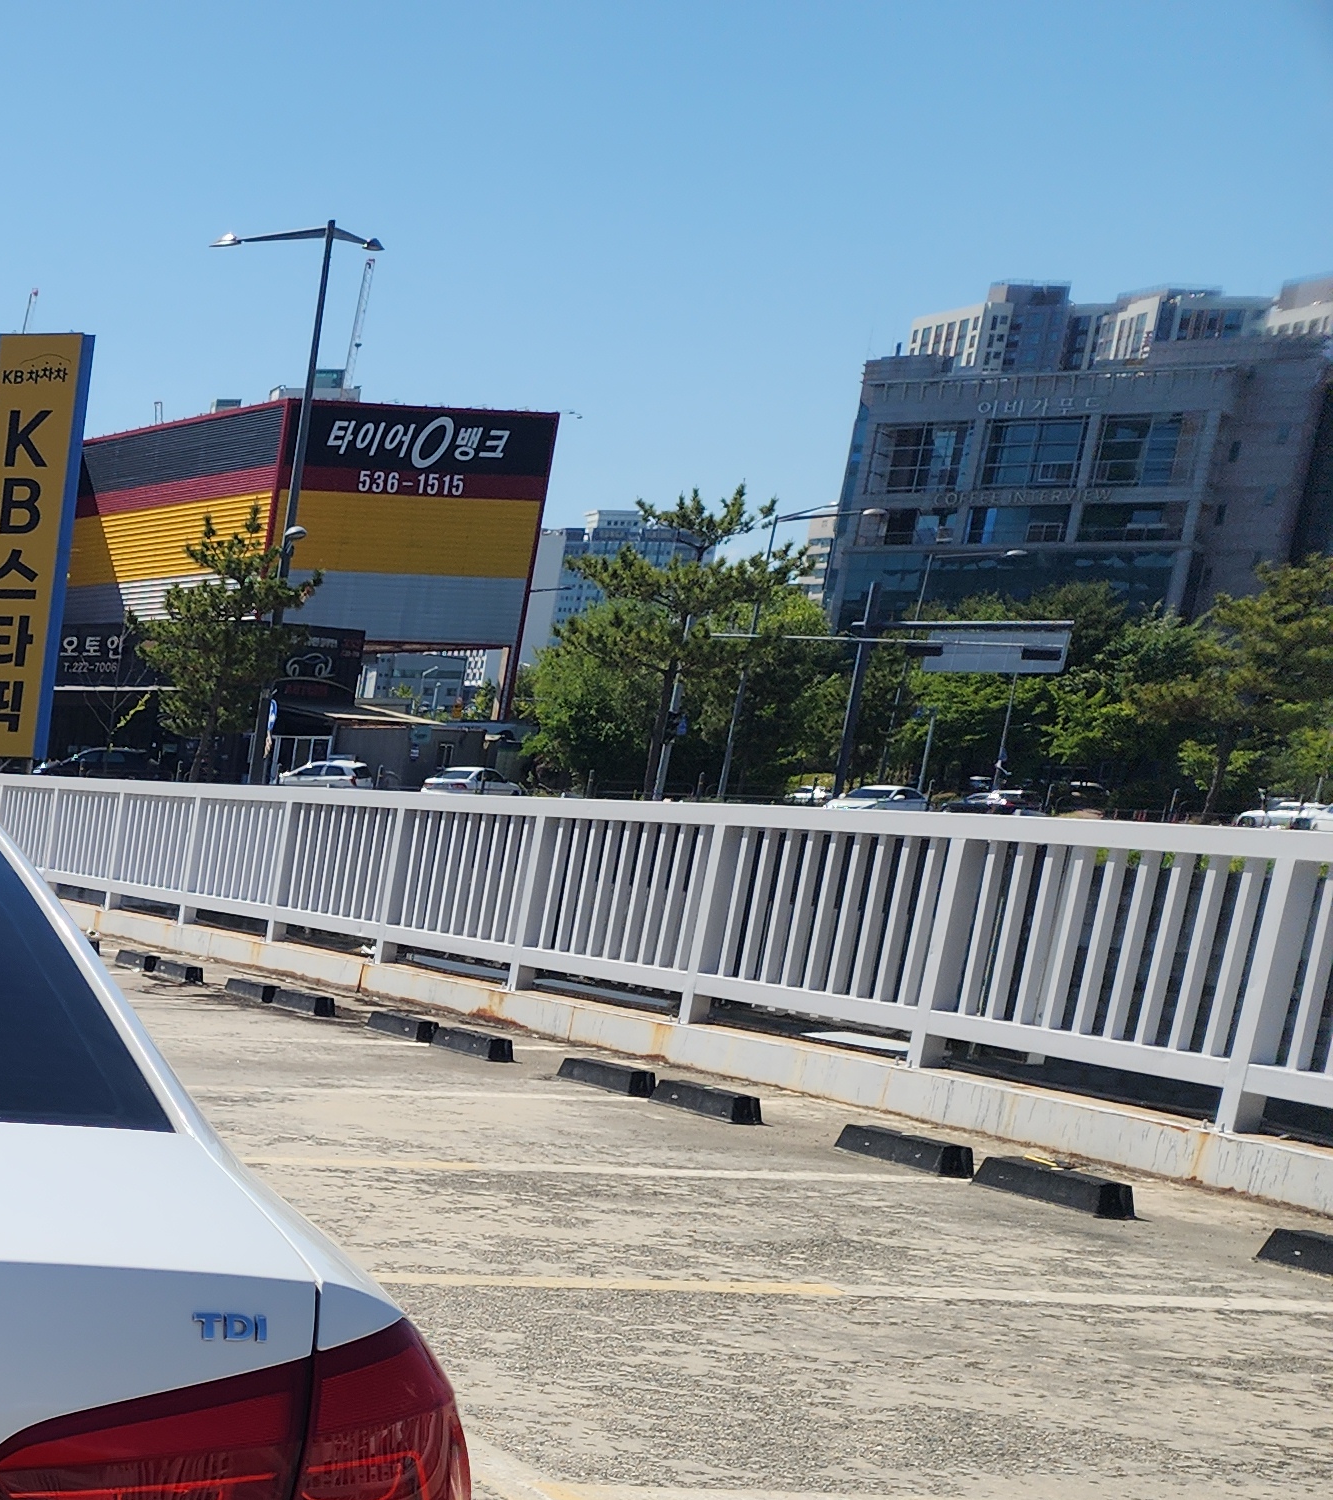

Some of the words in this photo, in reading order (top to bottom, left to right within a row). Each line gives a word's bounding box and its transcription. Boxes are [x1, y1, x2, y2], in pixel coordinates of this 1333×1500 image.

[358, 470, 464, 496] 536-1515
[934, 491, 1002, 506] COFFEE
[1008, 489, 1113, 503] INTERVIEW
[192, 1311, 268, 1343] TDI
